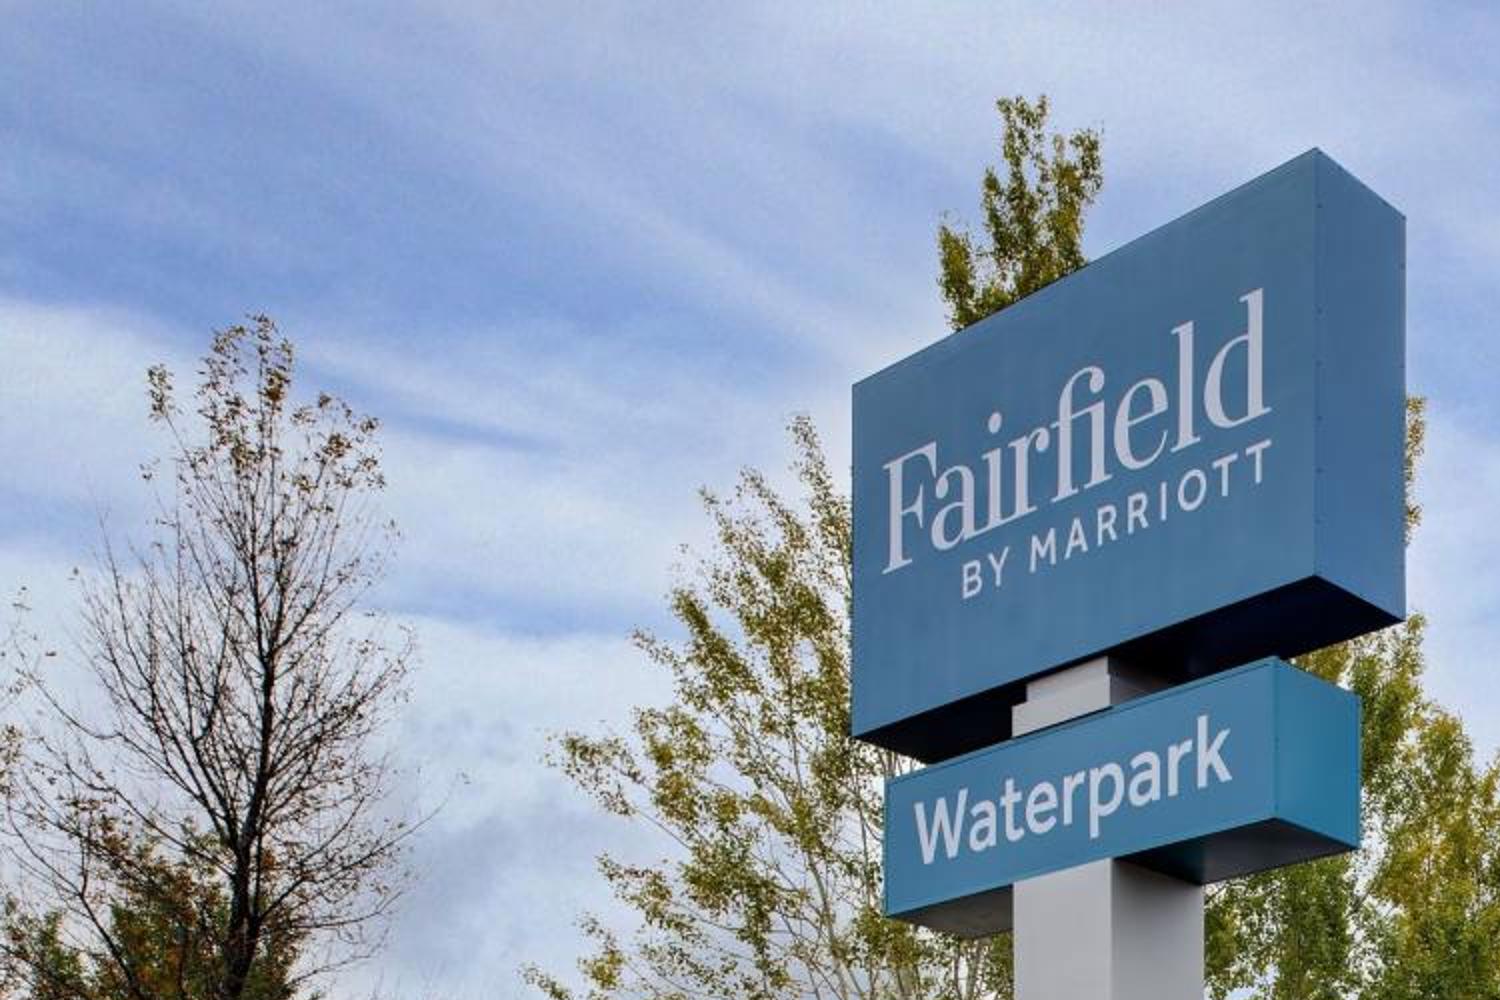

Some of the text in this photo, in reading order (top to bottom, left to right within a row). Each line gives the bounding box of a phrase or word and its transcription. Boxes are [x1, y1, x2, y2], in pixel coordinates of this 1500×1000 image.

[882, 287, 1272, 574] Fairfield
[962, 439, 1272, 599] BY MARRIOTT
[914, 715, 1232, 865] Waterpark
